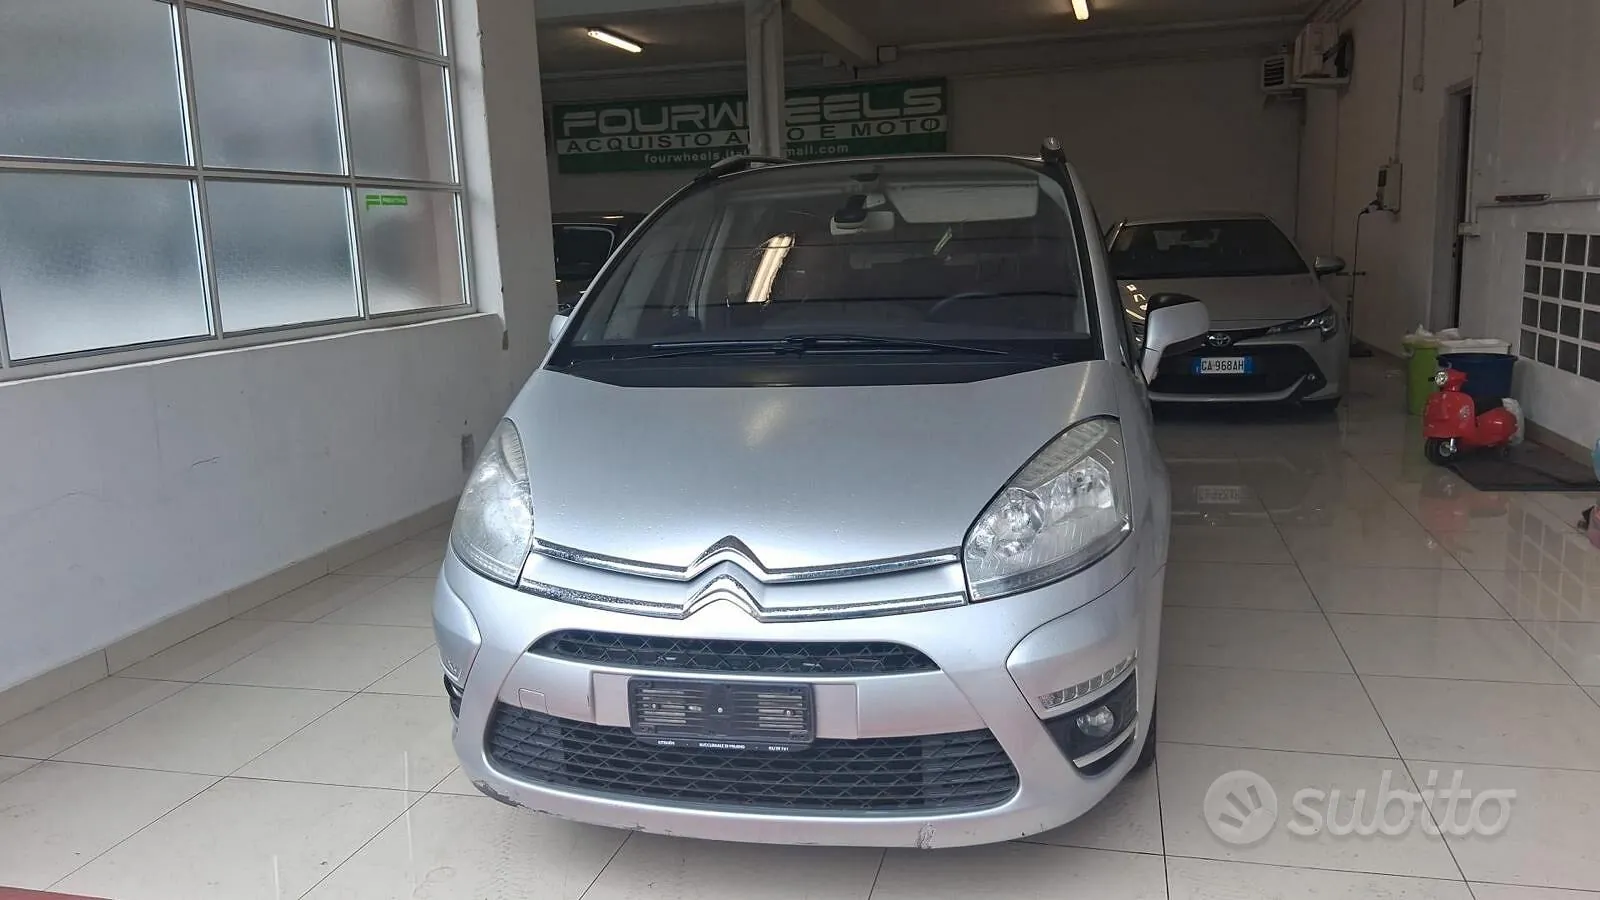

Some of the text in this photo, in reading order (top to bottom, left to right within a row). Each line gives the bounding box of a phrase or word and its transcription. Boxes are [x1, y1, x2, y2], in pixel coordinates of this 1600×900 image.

[563, 86, 941, 137] FOURWEELS
[566, 117, 941, 152] ACQUISTO AO E MOTO
